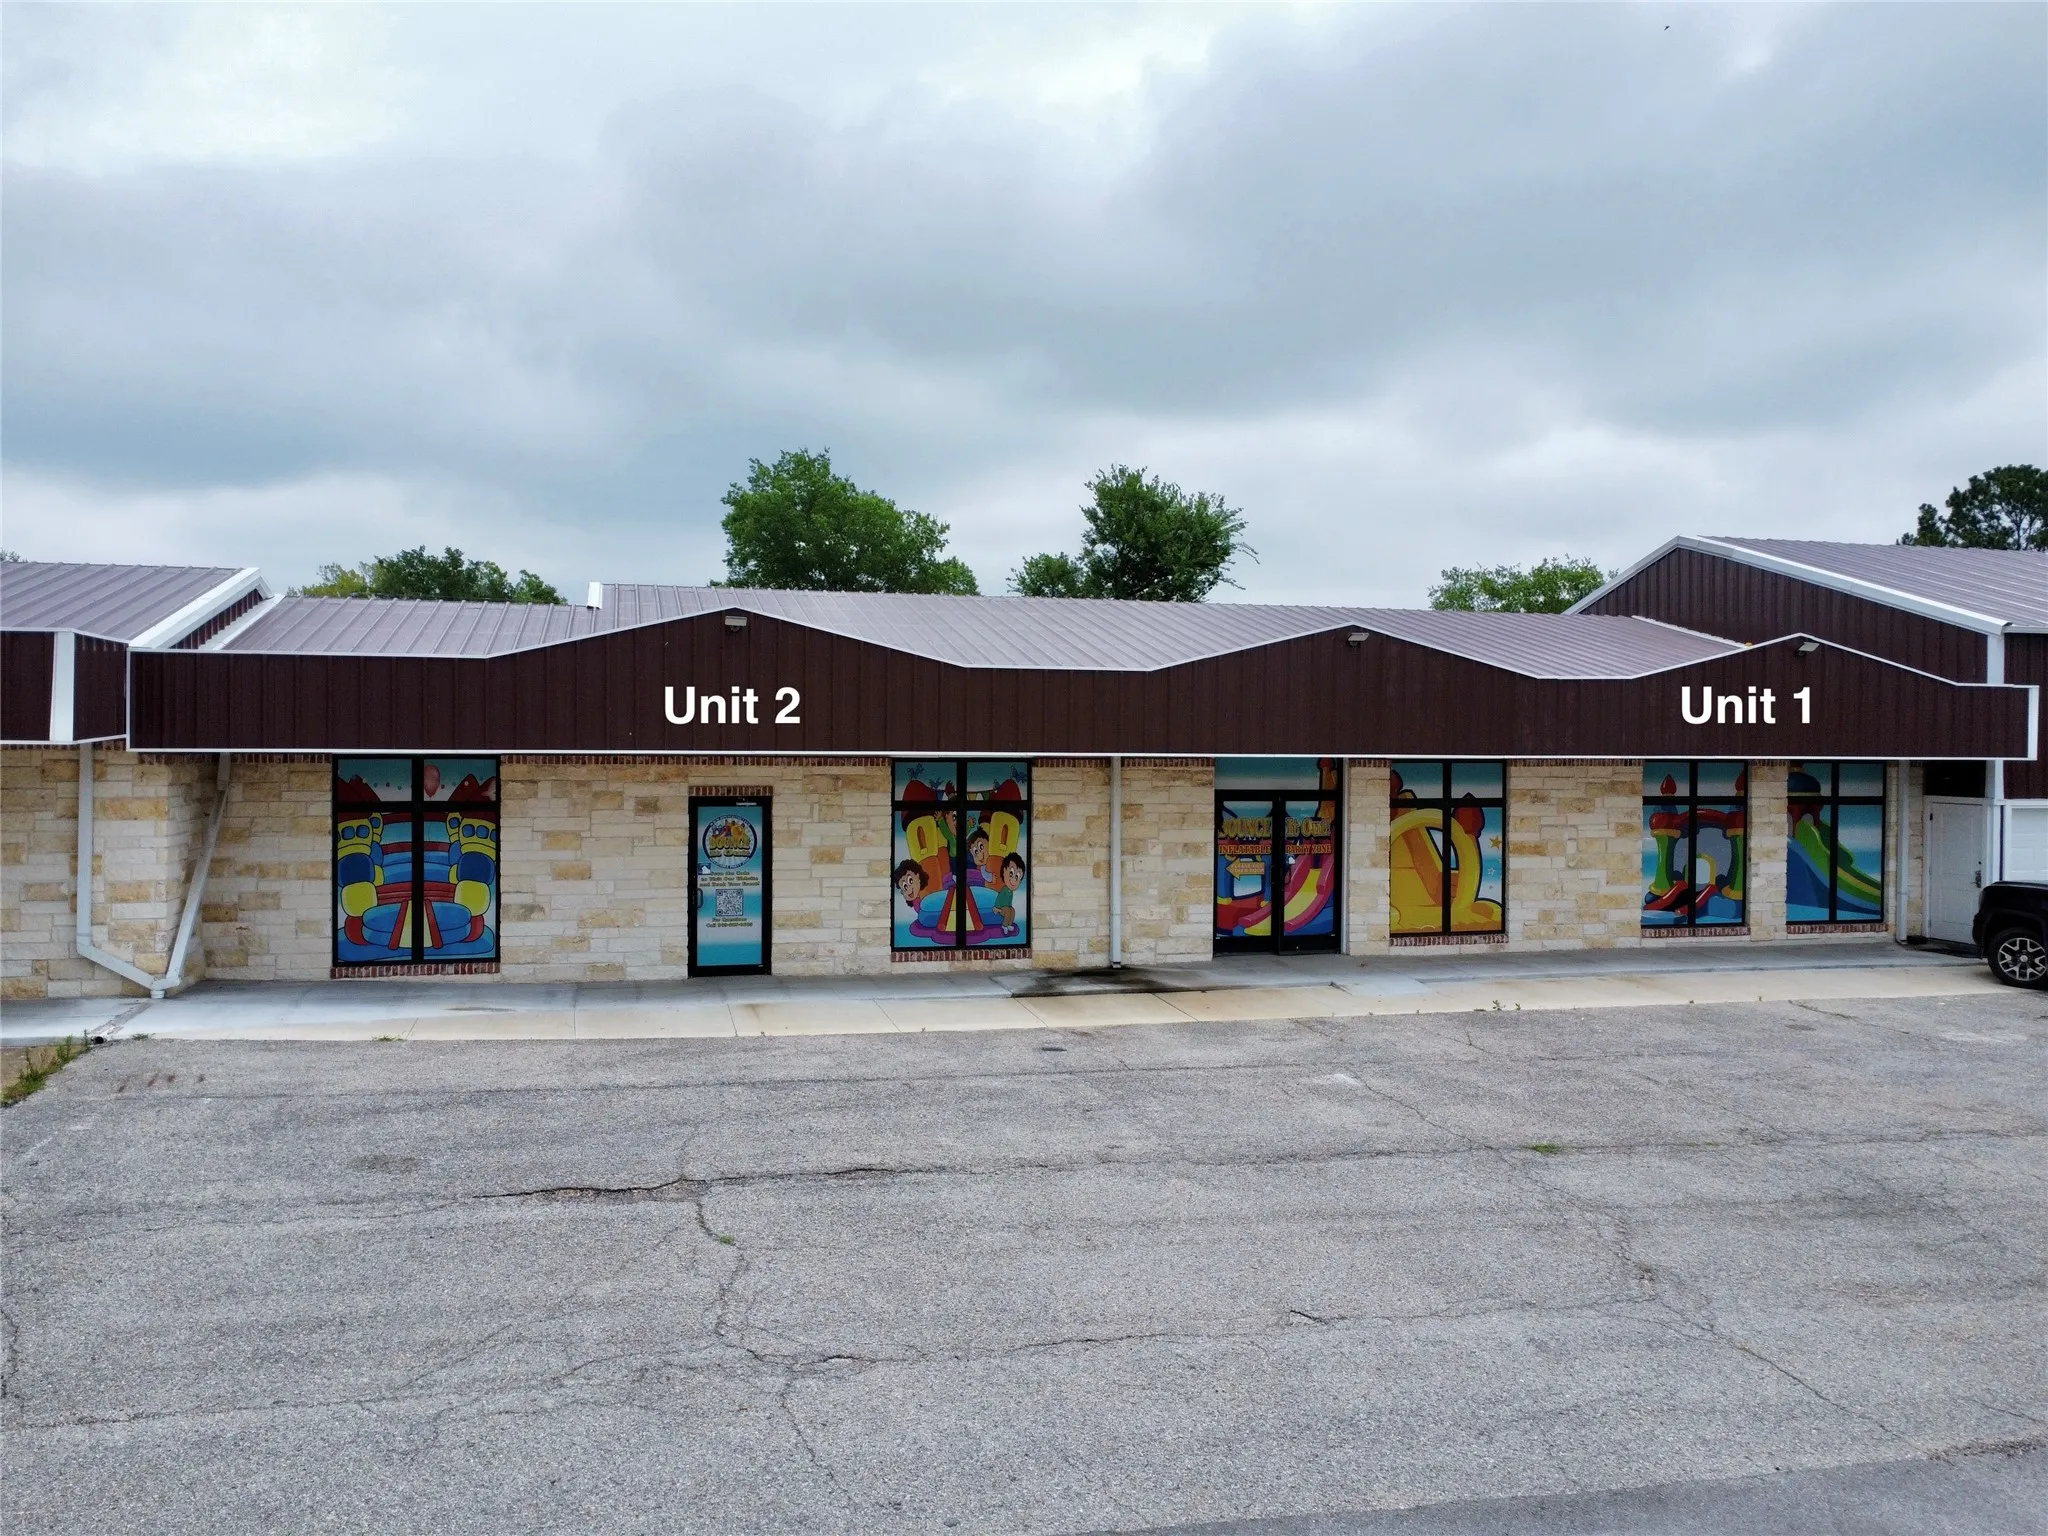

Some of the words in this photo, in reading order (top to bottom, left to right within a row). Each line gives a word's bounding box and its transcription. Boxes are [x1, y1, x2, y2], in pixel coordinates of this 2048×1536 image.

[1219, 844, 1272, 855] INFLATABLE
[1284, 844, 1311, 855] PARTY
[1312, 843, 1332, 854] ZONE
